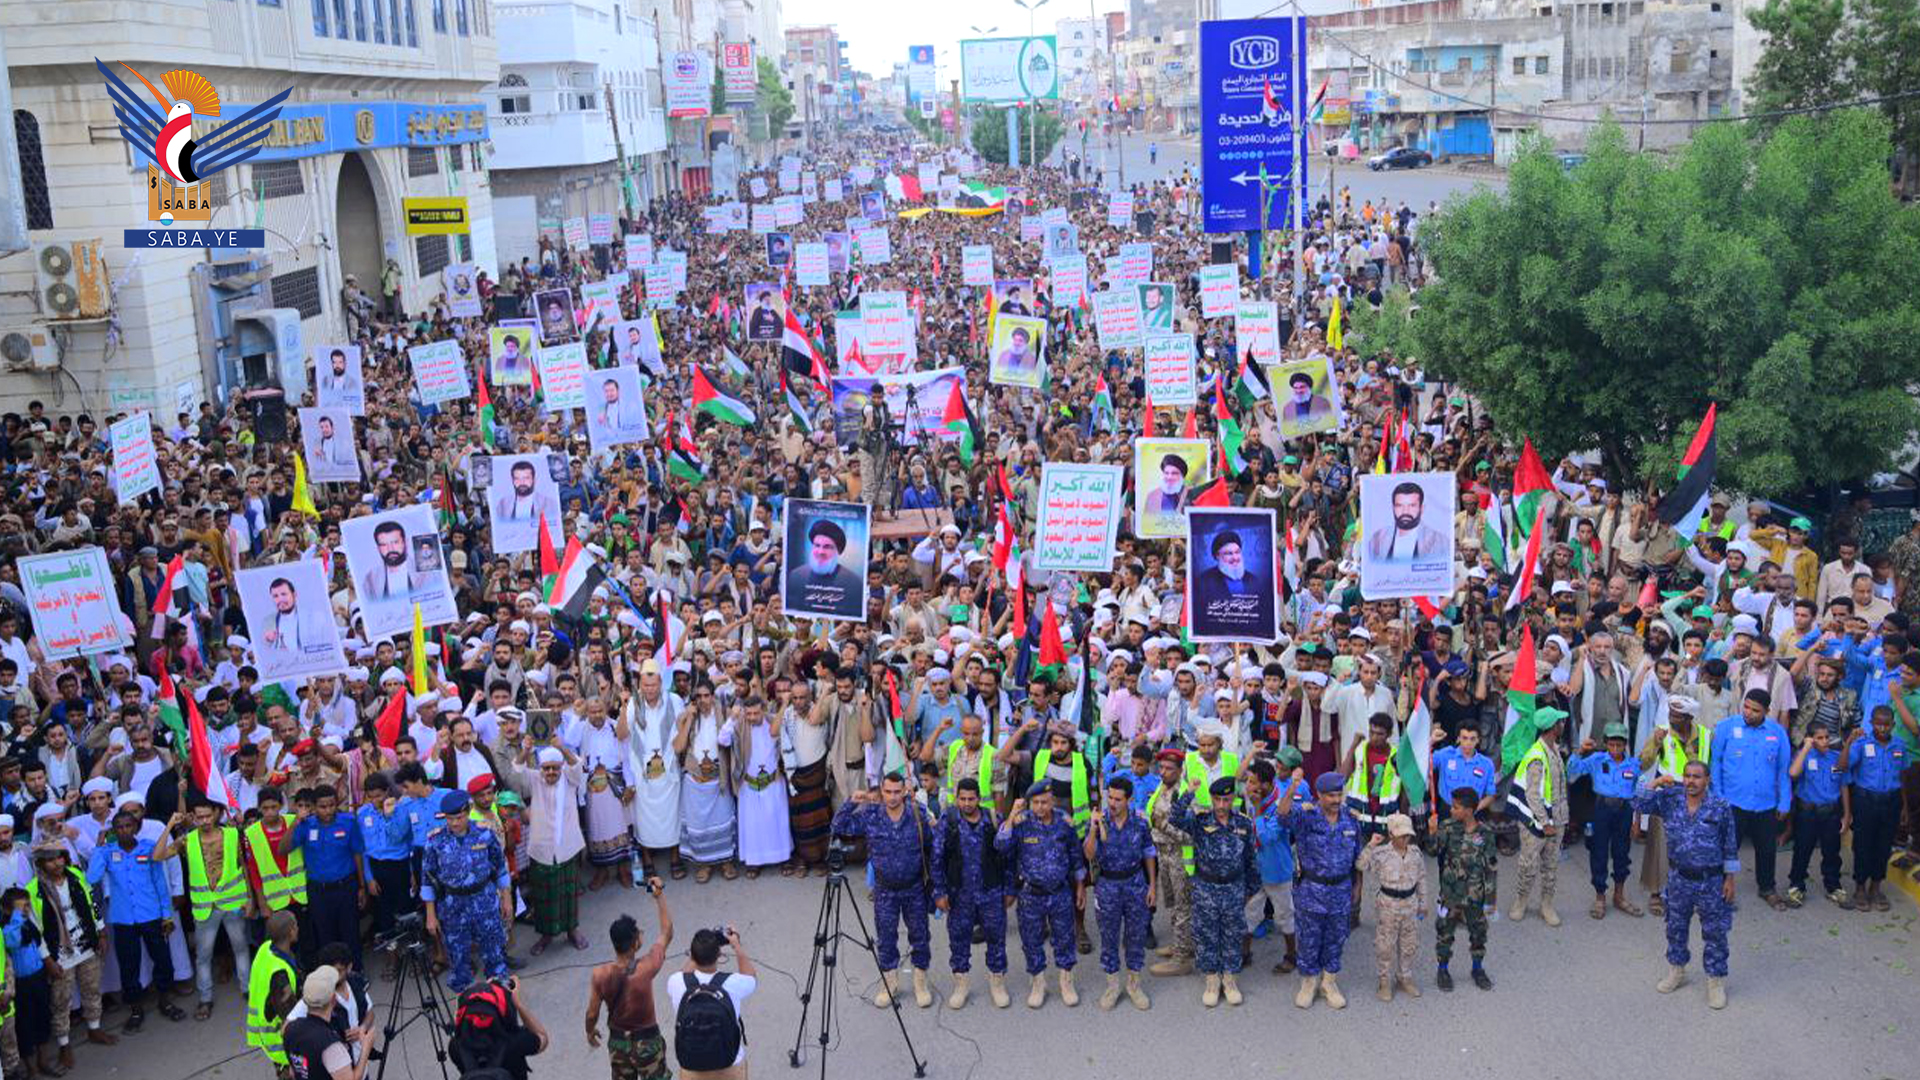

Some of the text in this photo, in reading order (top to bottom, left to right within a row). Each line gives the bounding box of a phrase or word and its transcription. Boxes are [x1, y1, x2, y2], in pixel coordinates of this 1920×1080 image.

[1235, 40, 1275, 64] YCB
[1219, 112, 1265, 128] لحديدة
[1089, 479, 1111, 493] الله
[28, 558, 93, 590] قاطعوا
